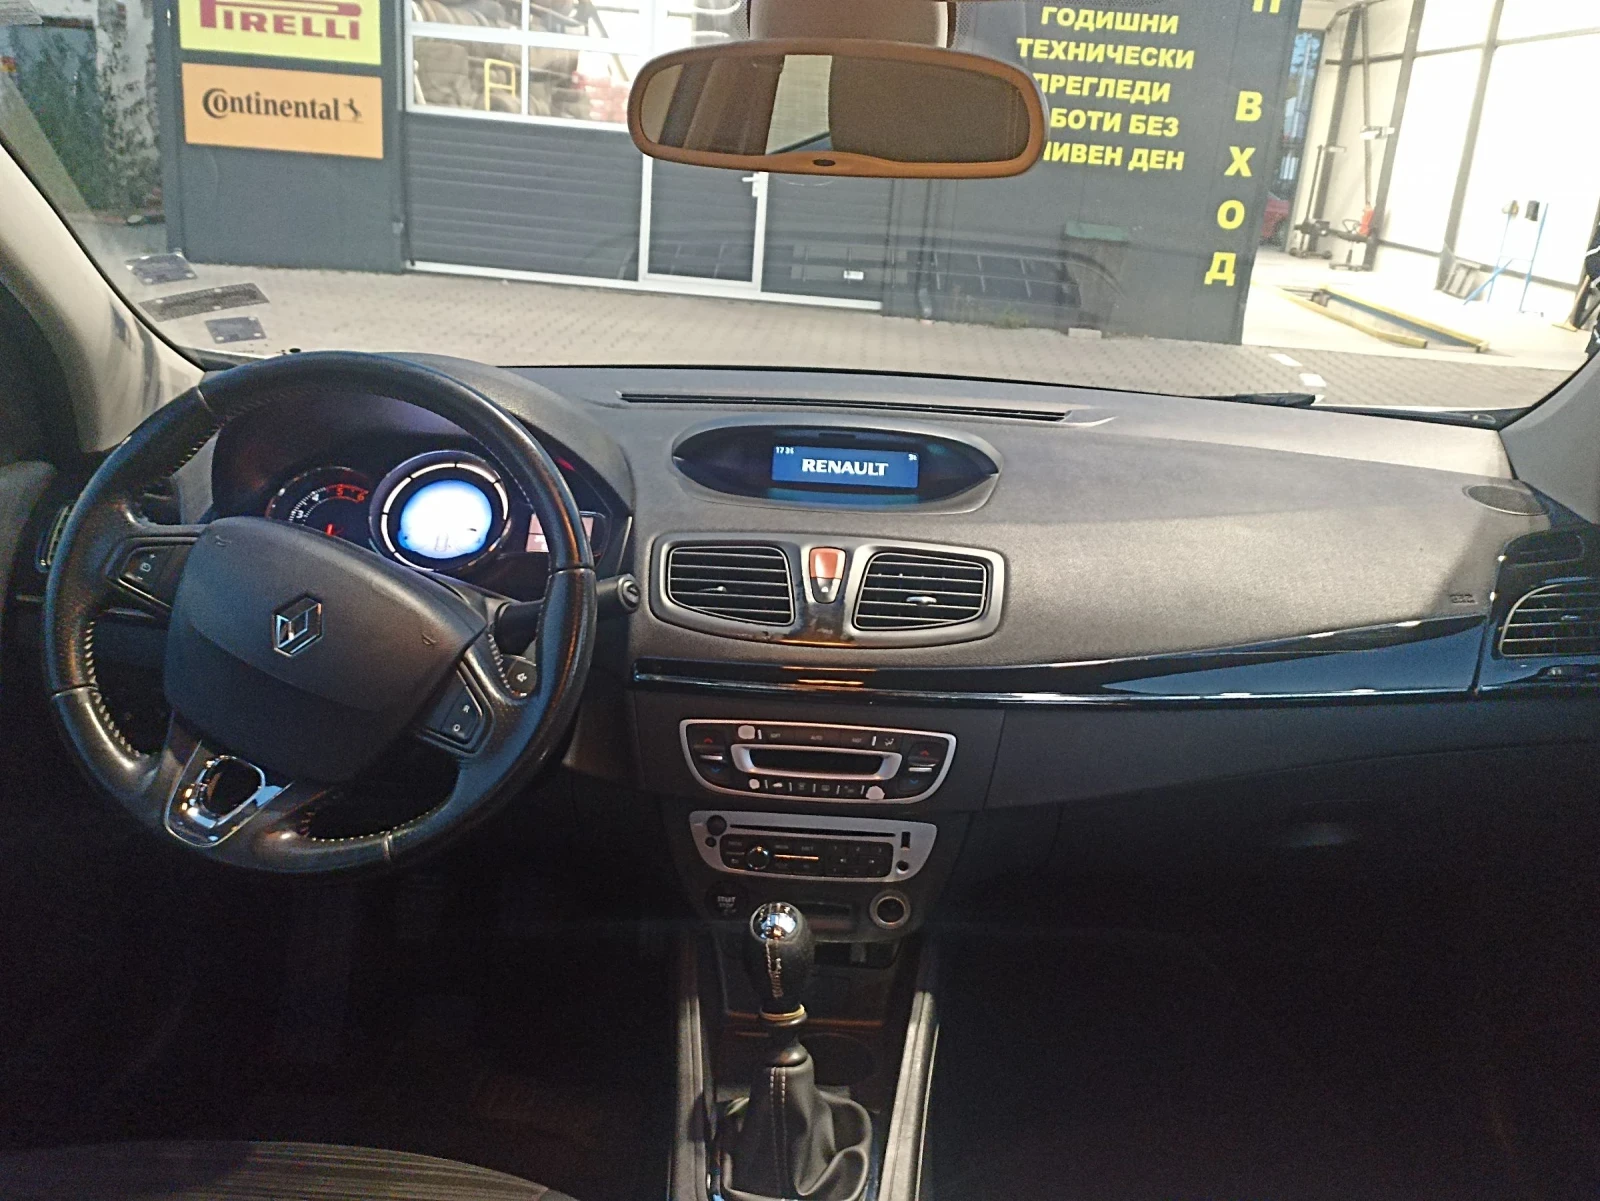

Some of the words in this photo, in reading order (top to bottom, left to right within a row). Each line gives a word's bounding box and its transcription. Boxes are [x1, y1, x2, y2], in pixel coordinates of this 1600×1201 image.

[200, 0, 361, 40] PIRELLI
[1041, 6, 1179, 34] ГОДИШНИ
[1016, 37, 1195, 70] ТЕХНИЧЕСКИ
[1033, 72, 1171, 104] ПРЕГЛЕДИ
[202, 87, 340, 121] Continental
[1050, 107, 1122, 133] БОТИ
[1128, 114, 1180, 138] БЕЗ
[1043, 141, 1123, 167] ИВЕН
[1127, 147, 1185, 172] ДЕН
[801, 458, 889, 477] RENAULT
